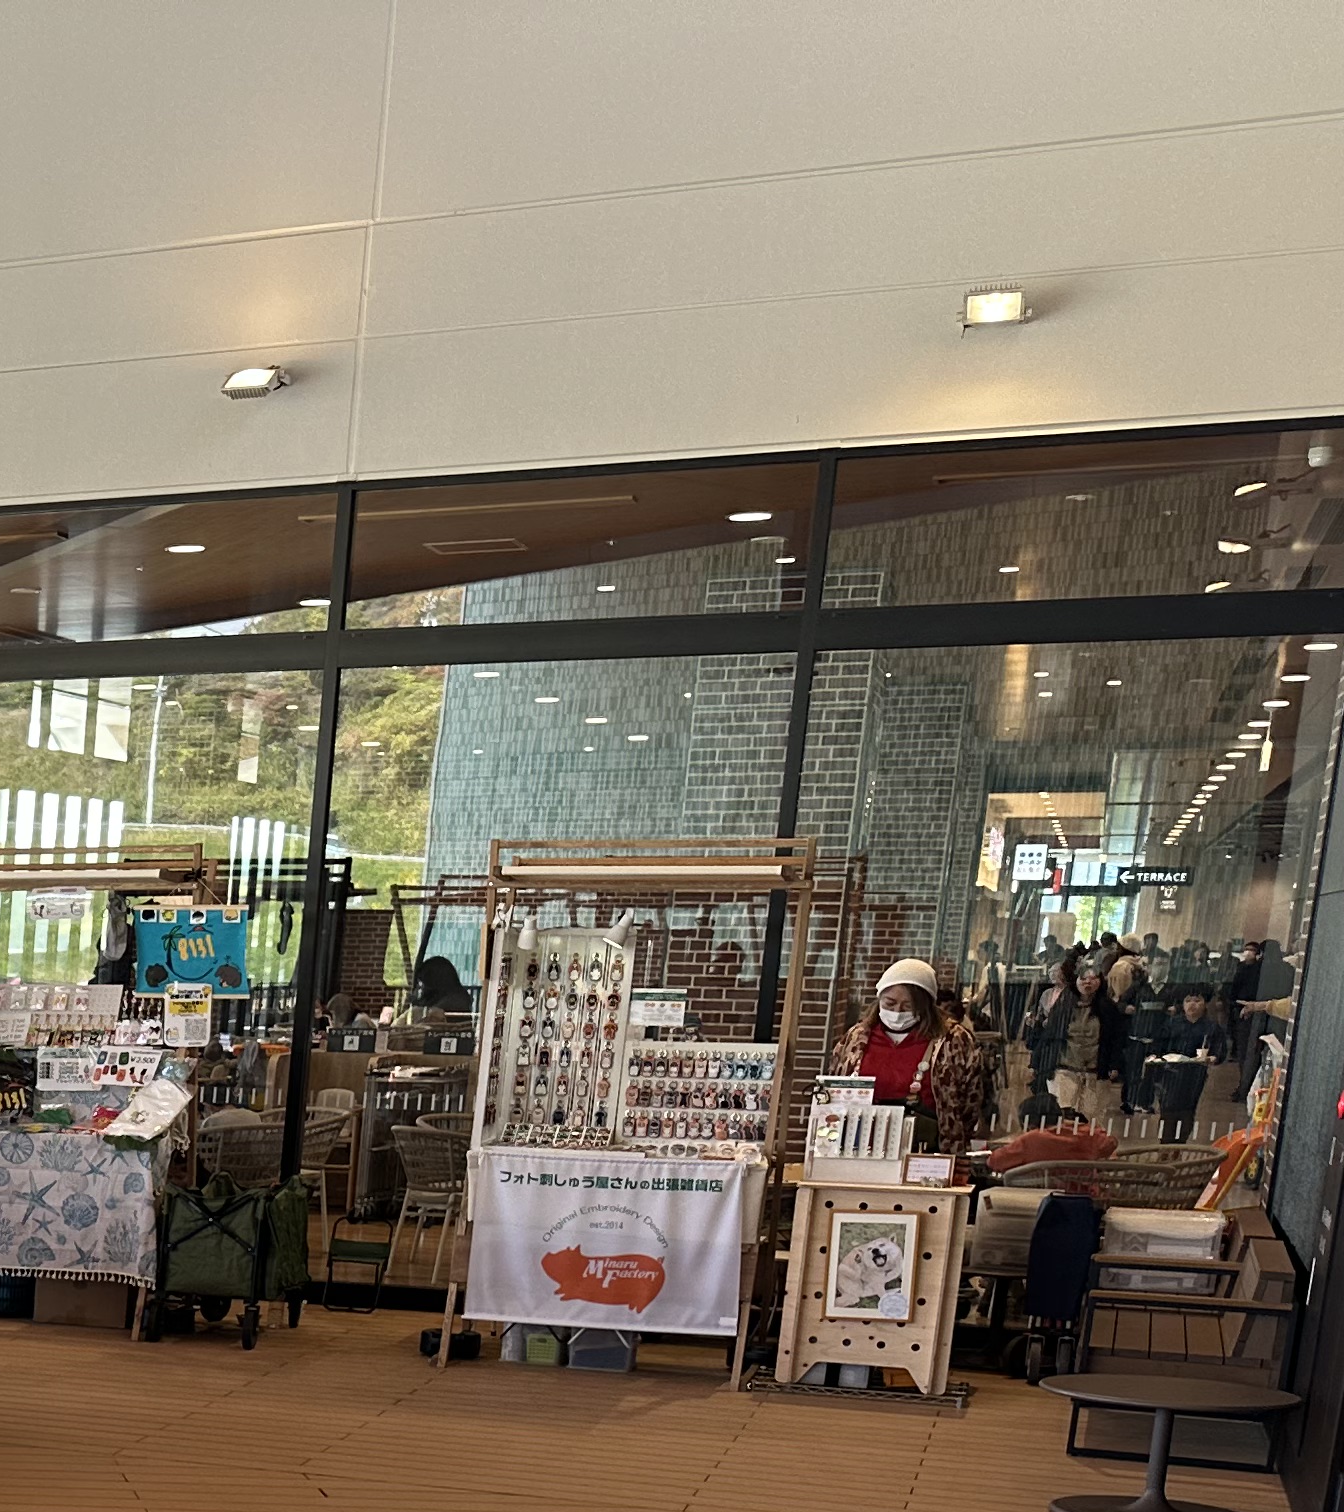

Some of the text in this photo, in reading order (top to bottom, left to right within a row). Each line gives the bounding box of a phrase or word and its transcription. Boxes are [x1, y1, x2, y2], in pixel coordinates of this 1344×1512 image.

[1136, 872, 1187, 882] TERRACE
[177, 934, 215, 961] 8131
[500, 1170, 724, 1193] フォト刺しゅう屋さんの出張雑貨店
[542, 1203, 669, 1250] Original Embroidery Design
